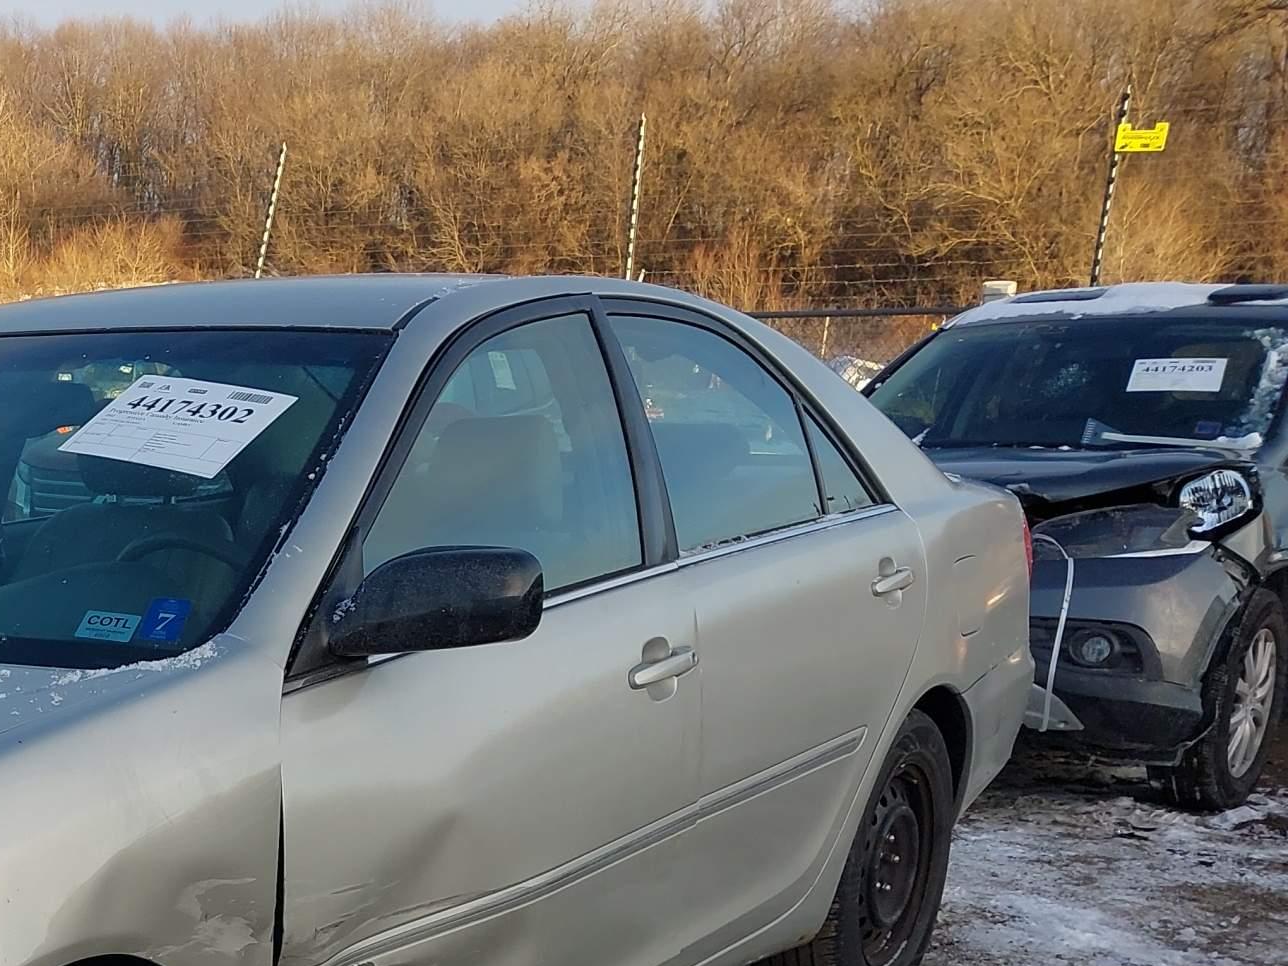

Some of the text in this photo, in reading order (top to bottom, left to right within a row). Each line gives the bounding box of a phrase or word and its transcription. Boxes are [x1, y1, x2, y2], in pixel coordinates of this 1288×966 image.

[1142, 364, 1213, 373] 44174203
[127, 395, 255, 424] 44174302
[87, 614, 132, 629] COTL
[155, 612, 177, 631] 7
